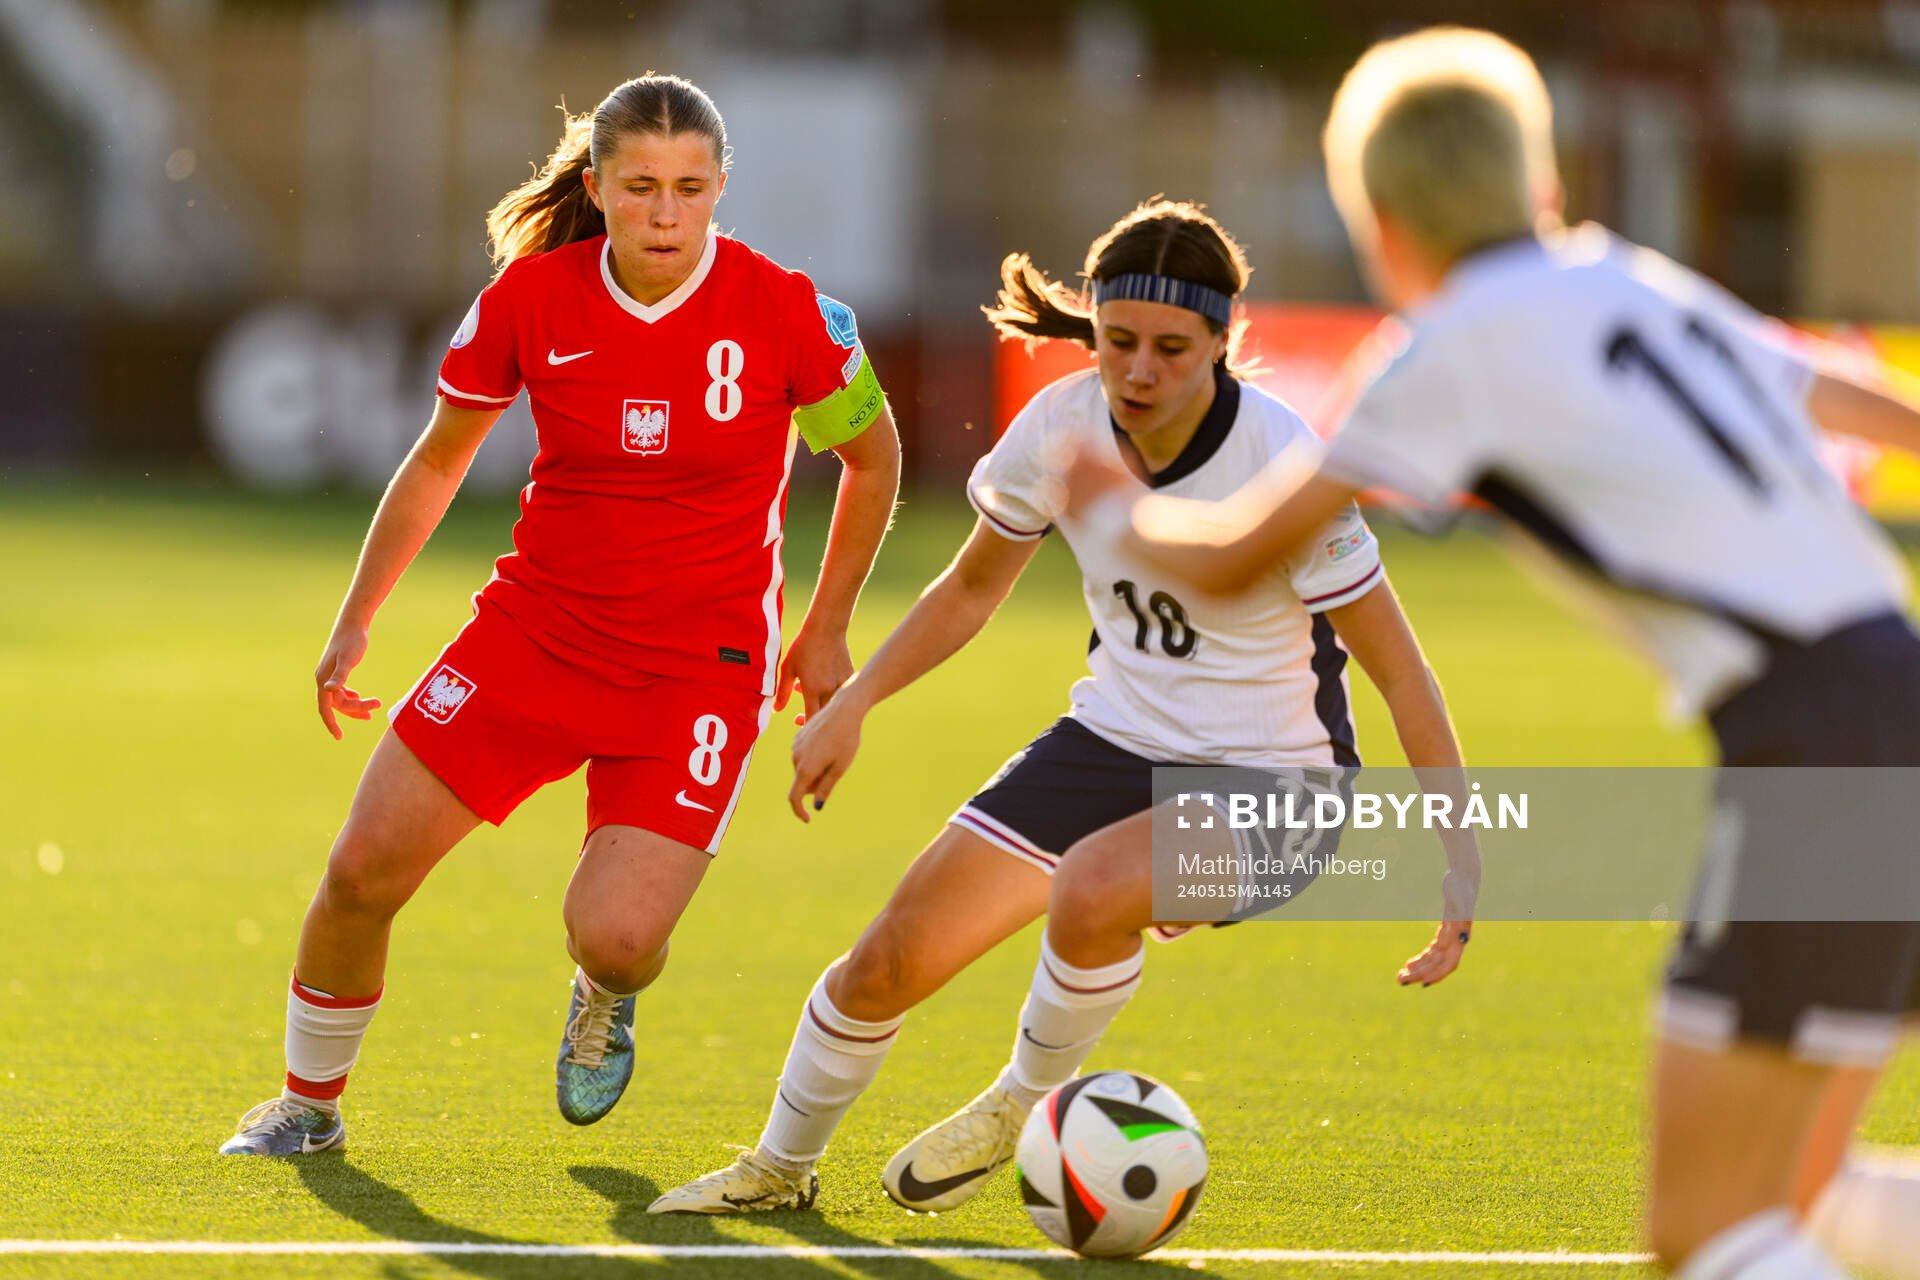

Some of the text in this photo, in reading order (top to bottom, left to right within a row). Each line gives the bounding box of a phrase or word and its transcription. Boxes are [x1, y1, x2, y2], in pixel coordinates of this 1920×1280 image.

[705, 339, 745, 422] 8
[849, 410, 867, 428] NO
[865, 395, 878, 411] TO
[1112, 579, 1199, 660] 10
[688, 714, 729, 787] 8
